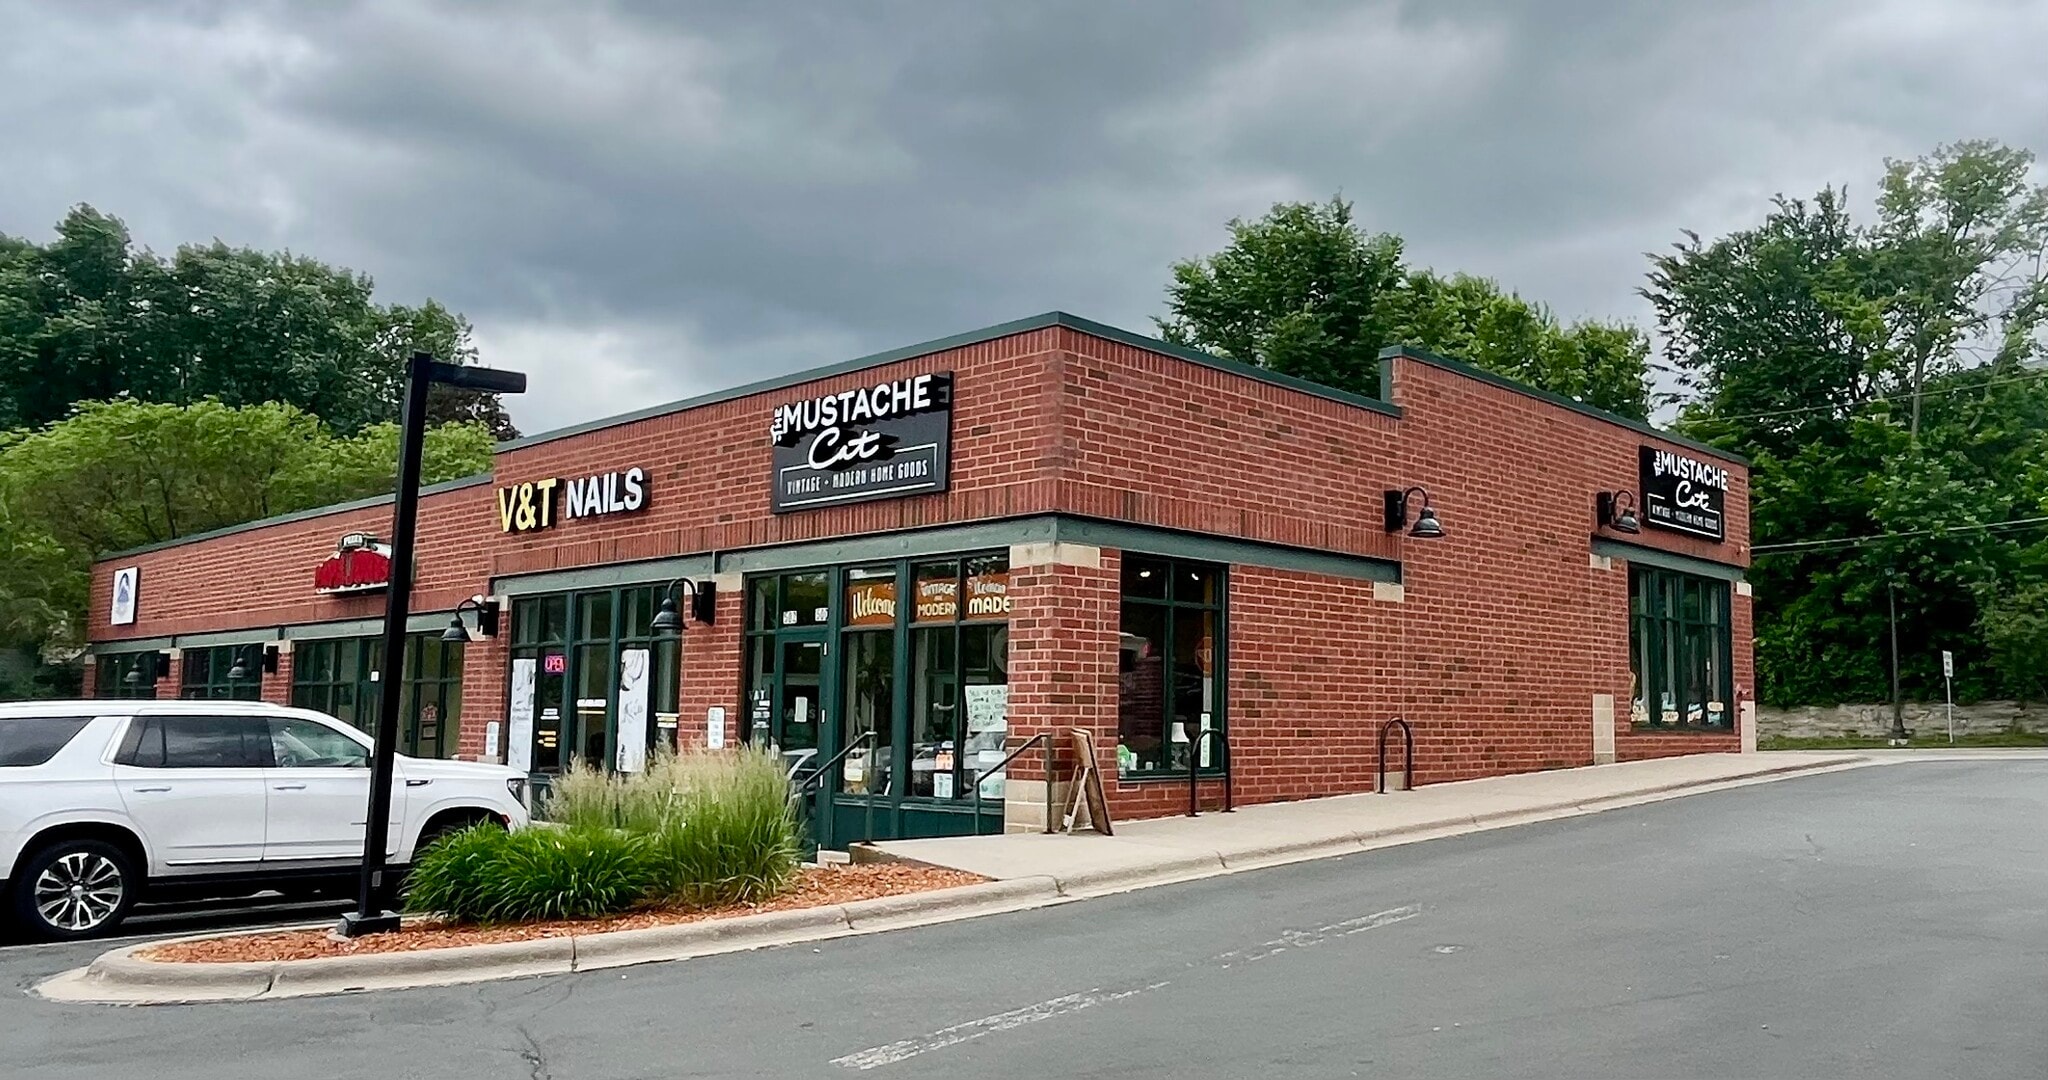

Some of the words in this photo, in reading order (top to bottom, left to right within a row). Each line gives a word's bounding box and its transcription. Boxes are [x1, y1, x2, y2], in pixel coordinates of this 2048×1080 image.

[783, 374, 932, 434] MUSTACHE
[770, 407, 783, 446] THE
[808, 427, 880, 469] Cat
[786, 477, 821, 495] VINTAGE
[832, 470, 867, 488] MODERN
[870, 465, 894, 483] HOME
[898, 460, 928, 479] GOODS
[1660, 451, 1729, 491] MUSTACHE
[498, 477, 557, 533] V&T
[566, 466, 643, 519] NAILS
[1675, 480, 1710, 509] Cat
[968, 596, 1011, 614] MADE
[545, 655, 565, 672] OPEN
